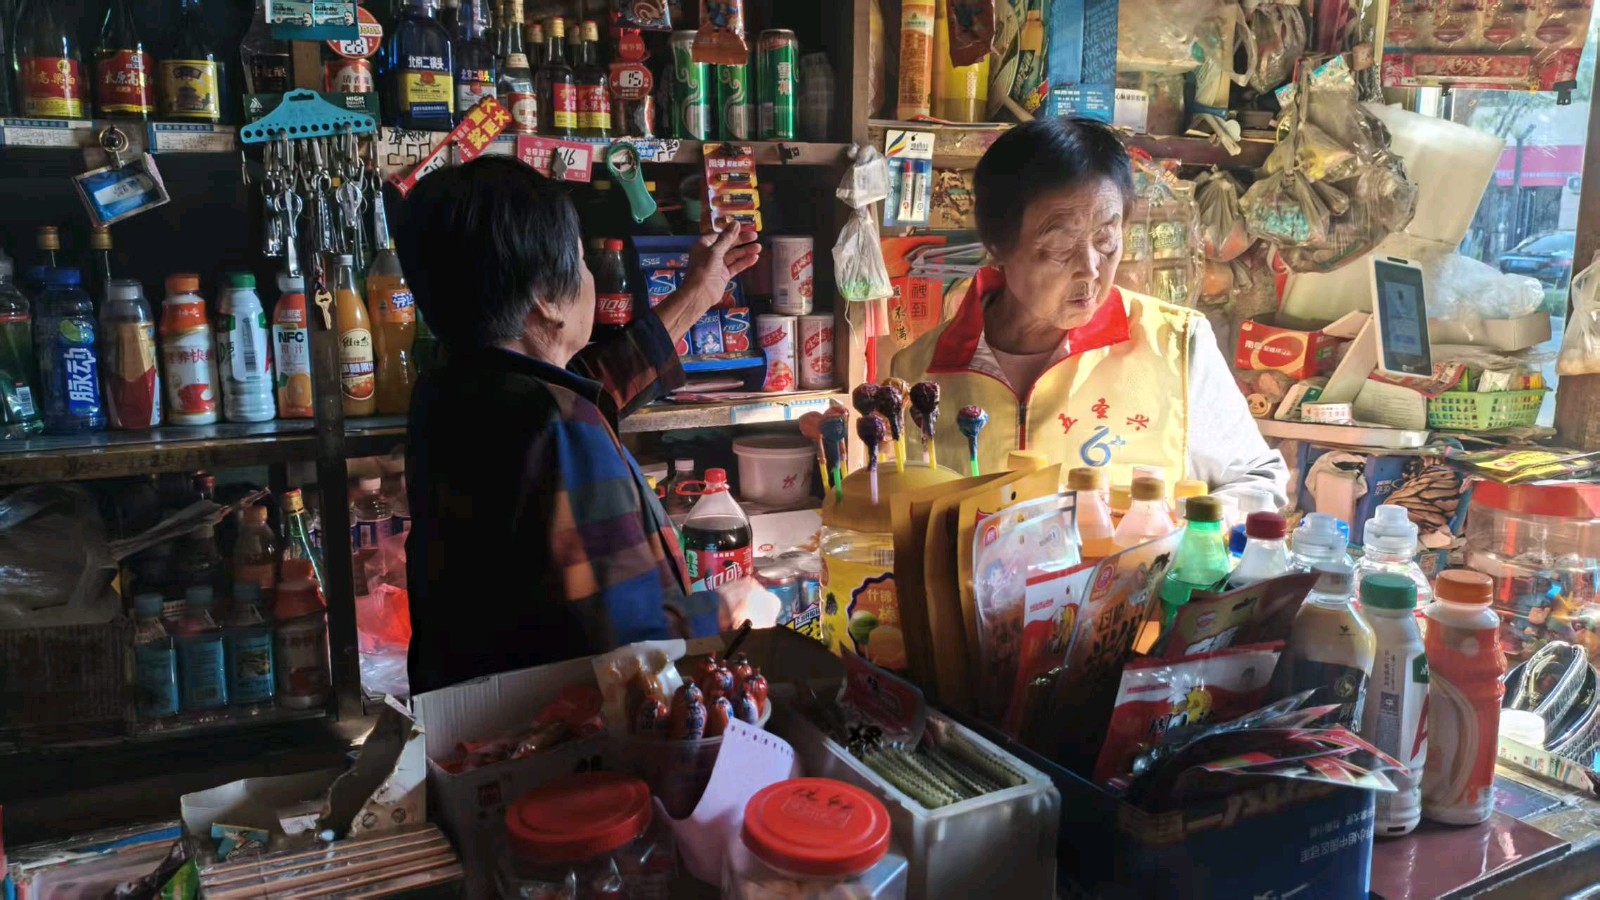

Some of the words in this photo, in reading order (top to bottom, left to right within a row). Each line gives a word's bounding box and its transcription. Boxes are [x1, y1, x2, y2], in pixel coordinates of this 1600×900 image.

[408, 55, 444, 70] 北京二锅头
[278, 331, 304, 344] NFC
[64, 348, 97, 404] 脉动
